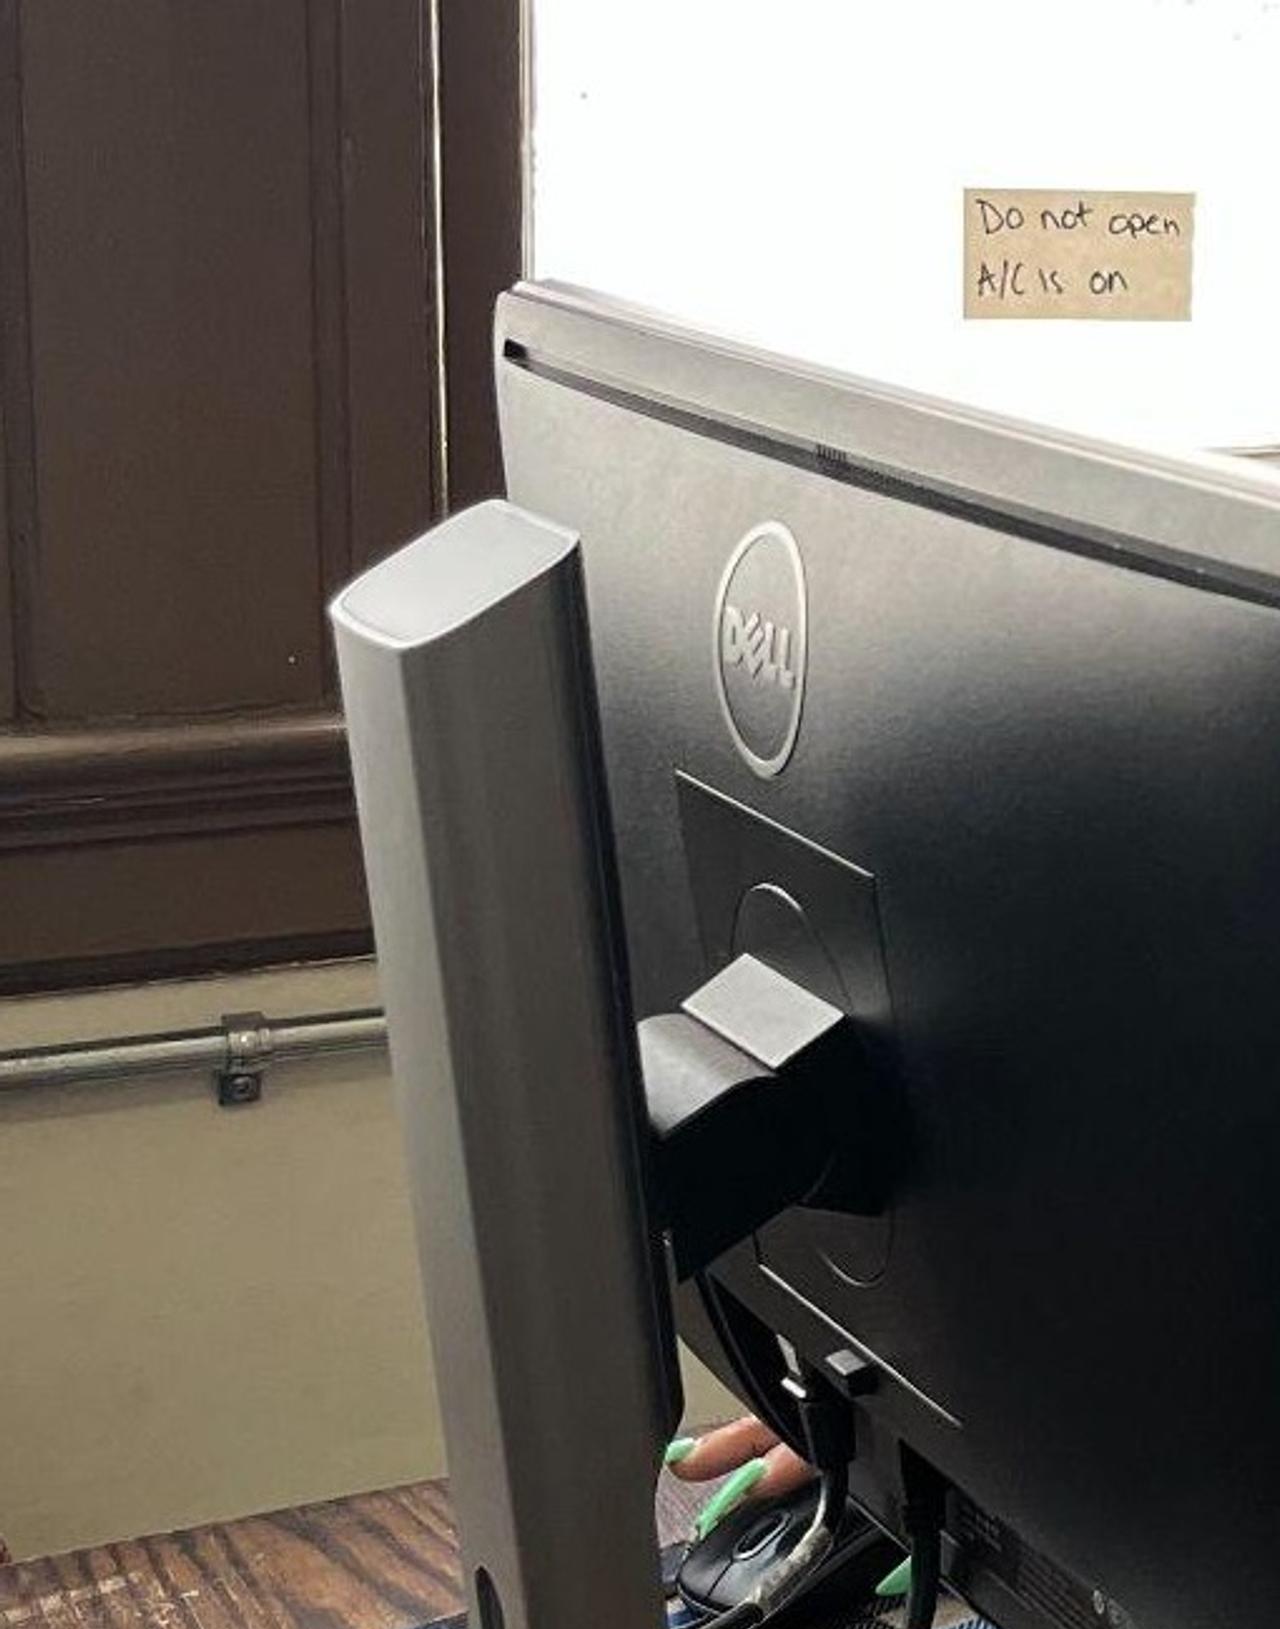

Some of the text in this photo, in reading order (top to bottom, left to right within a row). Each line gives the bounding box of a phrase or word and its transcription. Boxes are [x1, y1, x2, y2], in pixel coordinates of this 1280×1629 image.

[975, 198, 1181, 239] Do not open
[977, 259, 1026, 300] A/C
[1089, 270, 1129, 296] on
[723, 606, 795, 690] DELL
